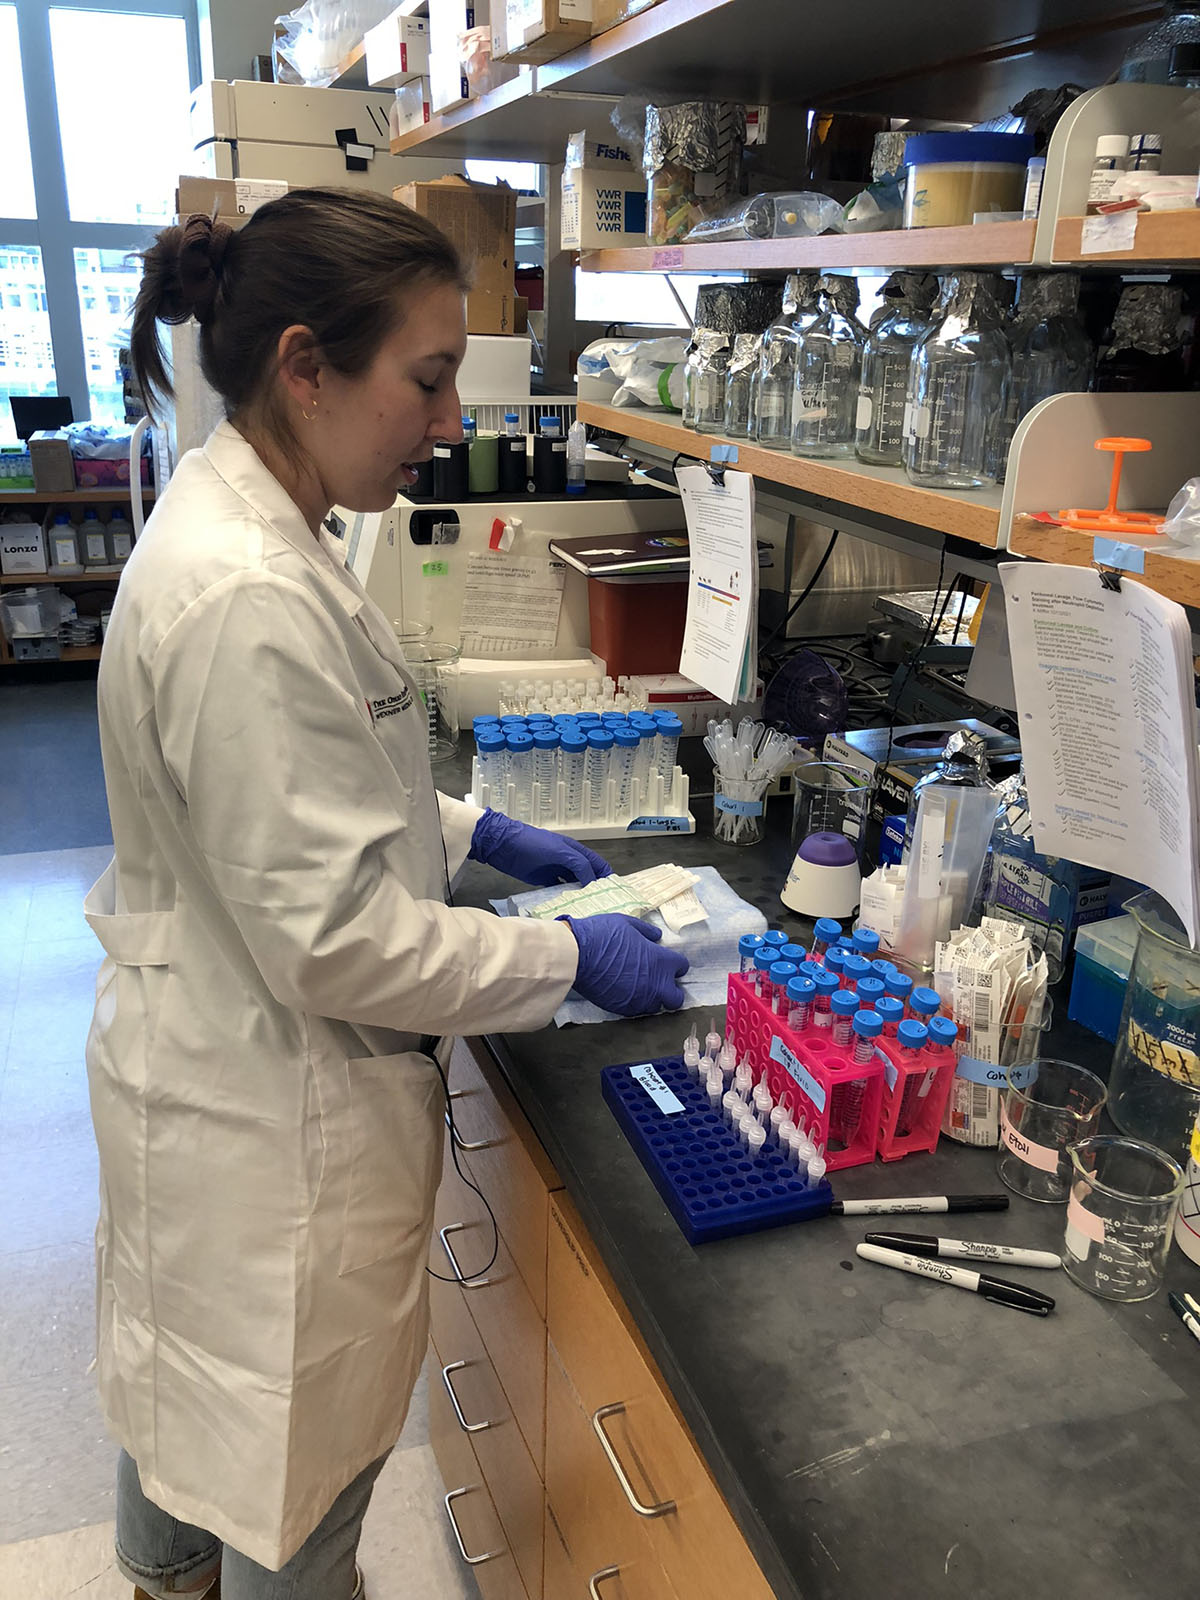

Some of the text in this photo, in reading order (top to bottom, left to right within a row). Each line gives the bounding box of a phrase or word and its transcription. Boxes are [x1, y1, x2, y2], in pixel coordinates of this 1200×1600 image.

[596, 189, 622, 200] VWR
[596, 200, 622, 211] VWR
[596, 211, 622, 222] VWR
[596, 222, 622, 233] VWR
[890, 401, 904, 409] 300
[1166, 1022, 1186, 1037] 2000
[1142, 1224, 1158, 1233] 200
[958, 1240, 1000, 1256] Sharpie
[1140, 1241, 1155, 1250] 150
[1098, 1252, 1114, 1264] 100
[1135, 1260, 1151, 1269] 100
[1094, 1270, 1110, 1282] 150
[1135, 1279, 1148, 1287] 50
